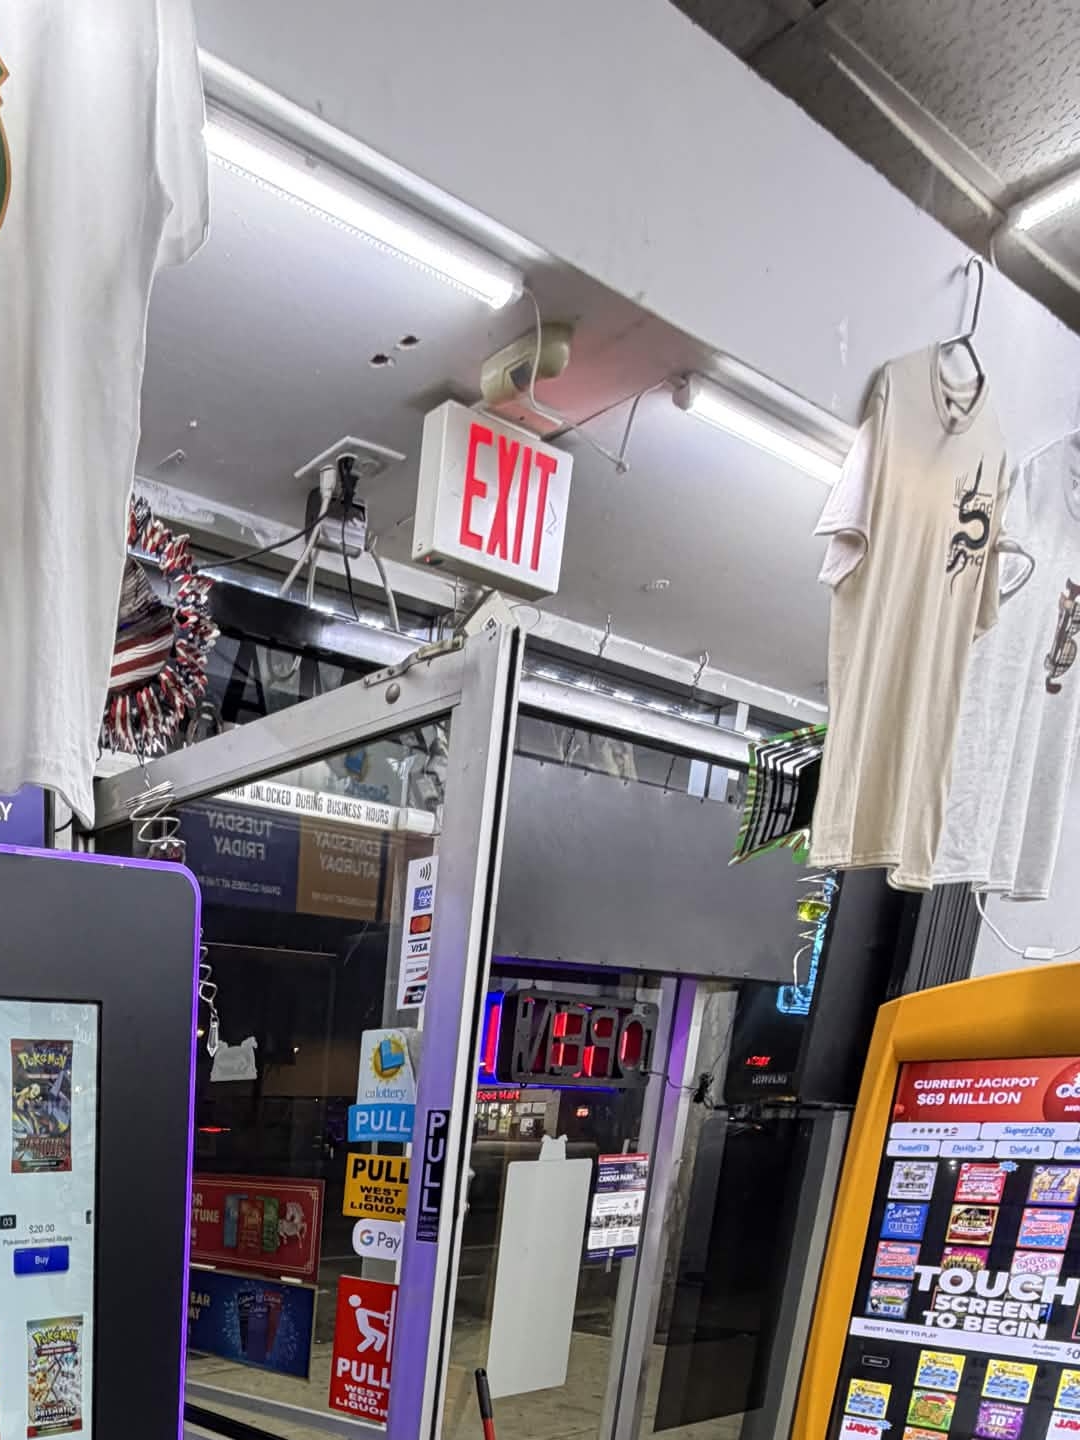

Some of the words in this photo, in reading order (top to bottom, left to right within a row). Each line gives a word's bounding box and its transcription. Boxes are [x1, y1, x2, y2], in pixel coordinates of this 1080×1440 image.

[459, 423, 558, 572] EXIT
[250, 784, 291, 806] UNLOCKED
[295, 792, 324, 813] DURING
[326, 799, 363, 819] BUSINESS
[366, 806, 390, 824] HOURS
[411, 943, 428, 953] VISA
[914, 1078, 974, 1090] CURRENT
[974, 1077, 1040, 1089] JACKPOT
[916, 1093, 945, 1106] $69
[948, 1092, 1022, 1105] MILLION
[355, 1110, 411, 1133] PULL
[422, 1111, 446, 1213] PULL
[351, 1158, 410, 1185] PULL
[360, 1185, 402, 1196] WEST
[364, 1193, 395, 1204] END
[350, 1201, 406, 1216] LIQUOR
[2, 1217, 13, 1227] 03
[28, 1224, 55, 1234] $20.00
[377, 1231, 401, 1254] Pay
[34, 1255, 49, 1266] Buy
[914, 1264, 1079, 1306] TOUCH
[934, 1294, 1042, 1320] SCREEN
[885, 1327, 910, 1336] MONEY
[922, 1311, 957, 1328] TO
[963, 1314, 1048, 1340] BEGIN
[336, 1357, 391, 1389] PULL
[344, 1383, 384, 1400] WEST
[348, 1392, 377, 1406] END
[845, 1421, 879, 1436] JAWS
